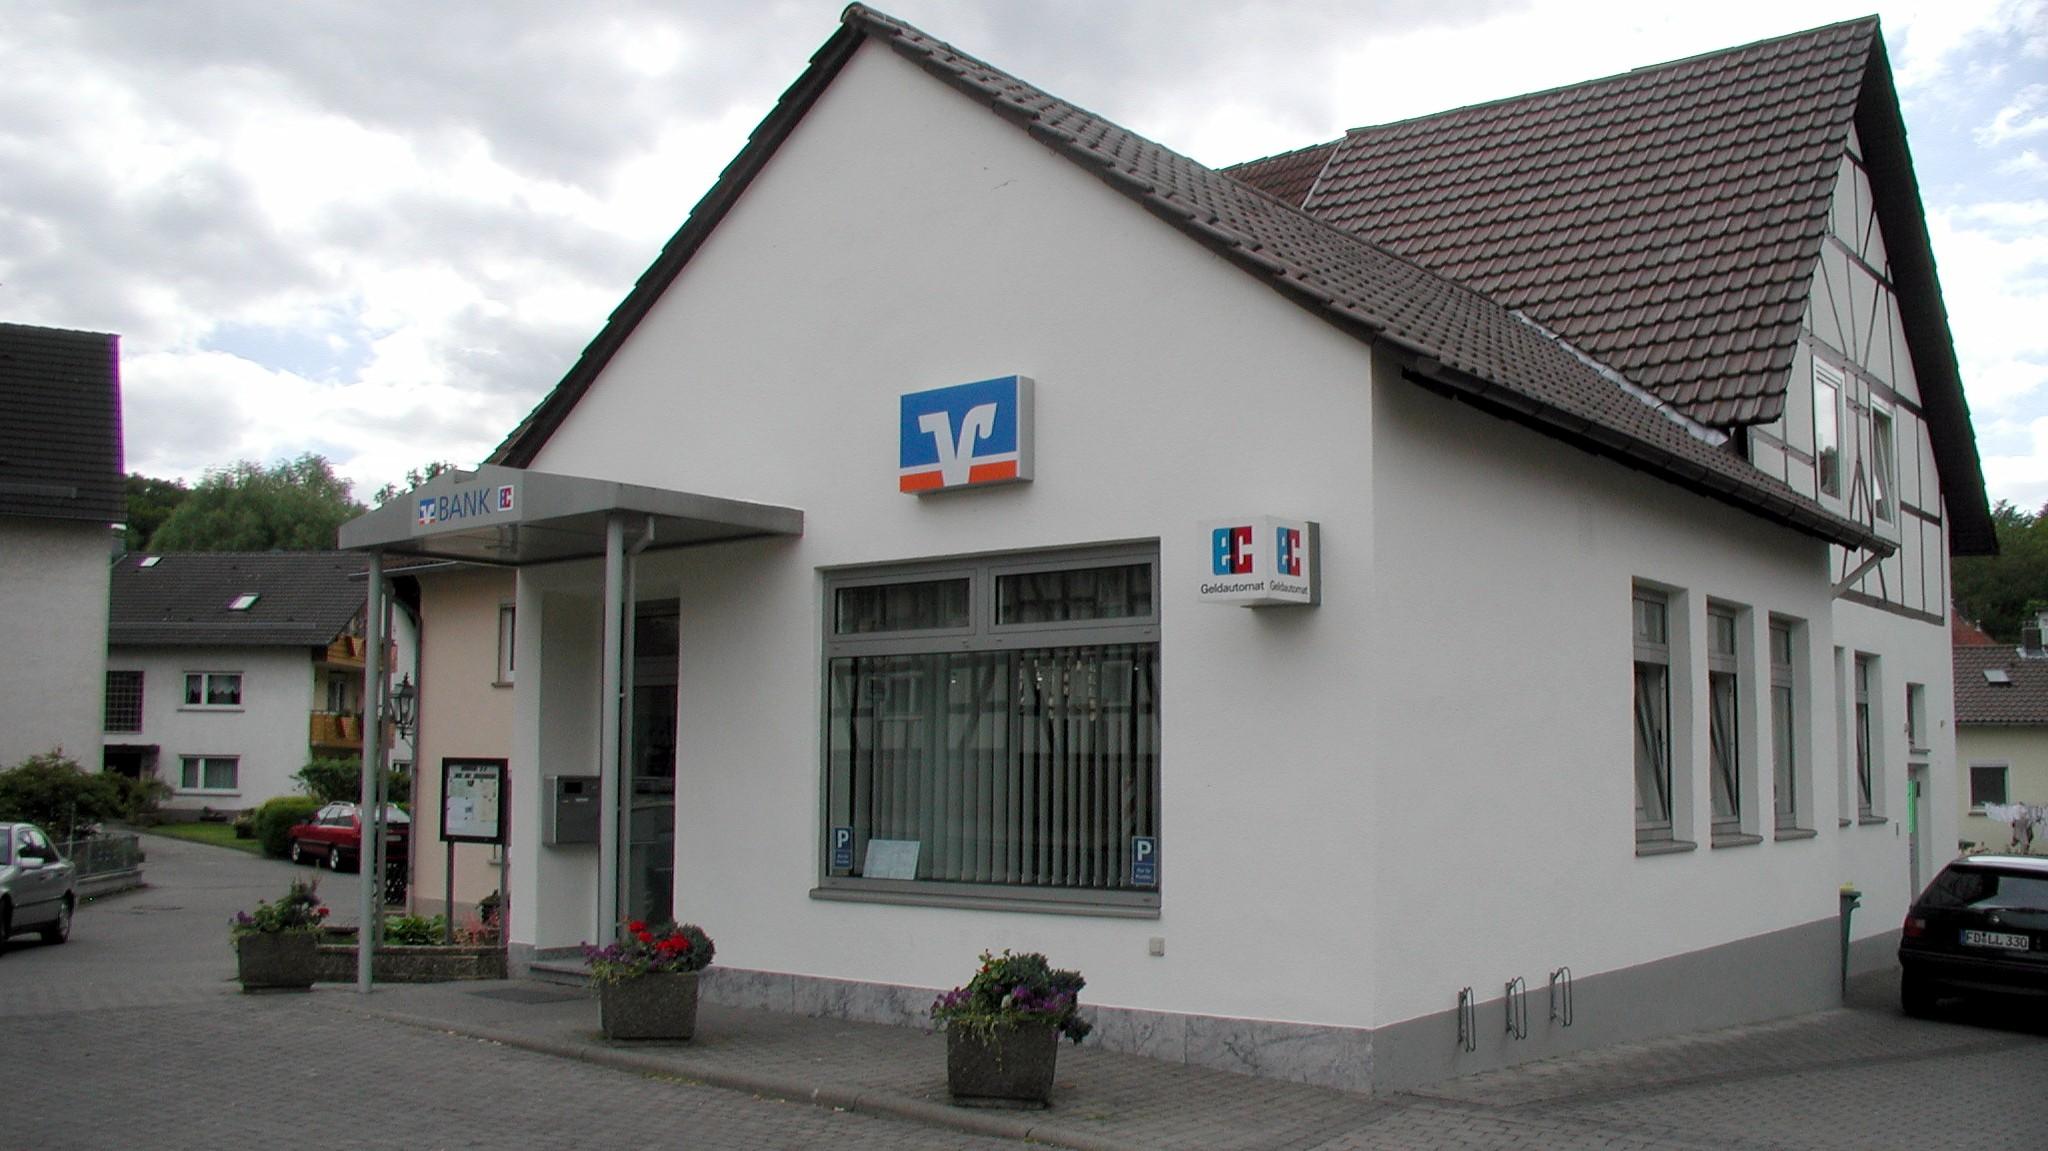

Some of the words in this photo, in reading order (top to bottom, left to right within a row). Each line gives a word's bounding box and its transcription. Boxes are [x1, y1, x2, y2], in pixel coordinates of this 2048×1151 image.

[439, 488, 491, 521] BANK
[1200, 581, 1265, 595] Geldautomat
[1269, 580, 1308, 595] Geldautomat
[837, 830, 849, 848] P
[1137, 841, 1152, 861] P
[1966, 931, 1982, 943] FD
[2006, 935, 2028, 948] 330
